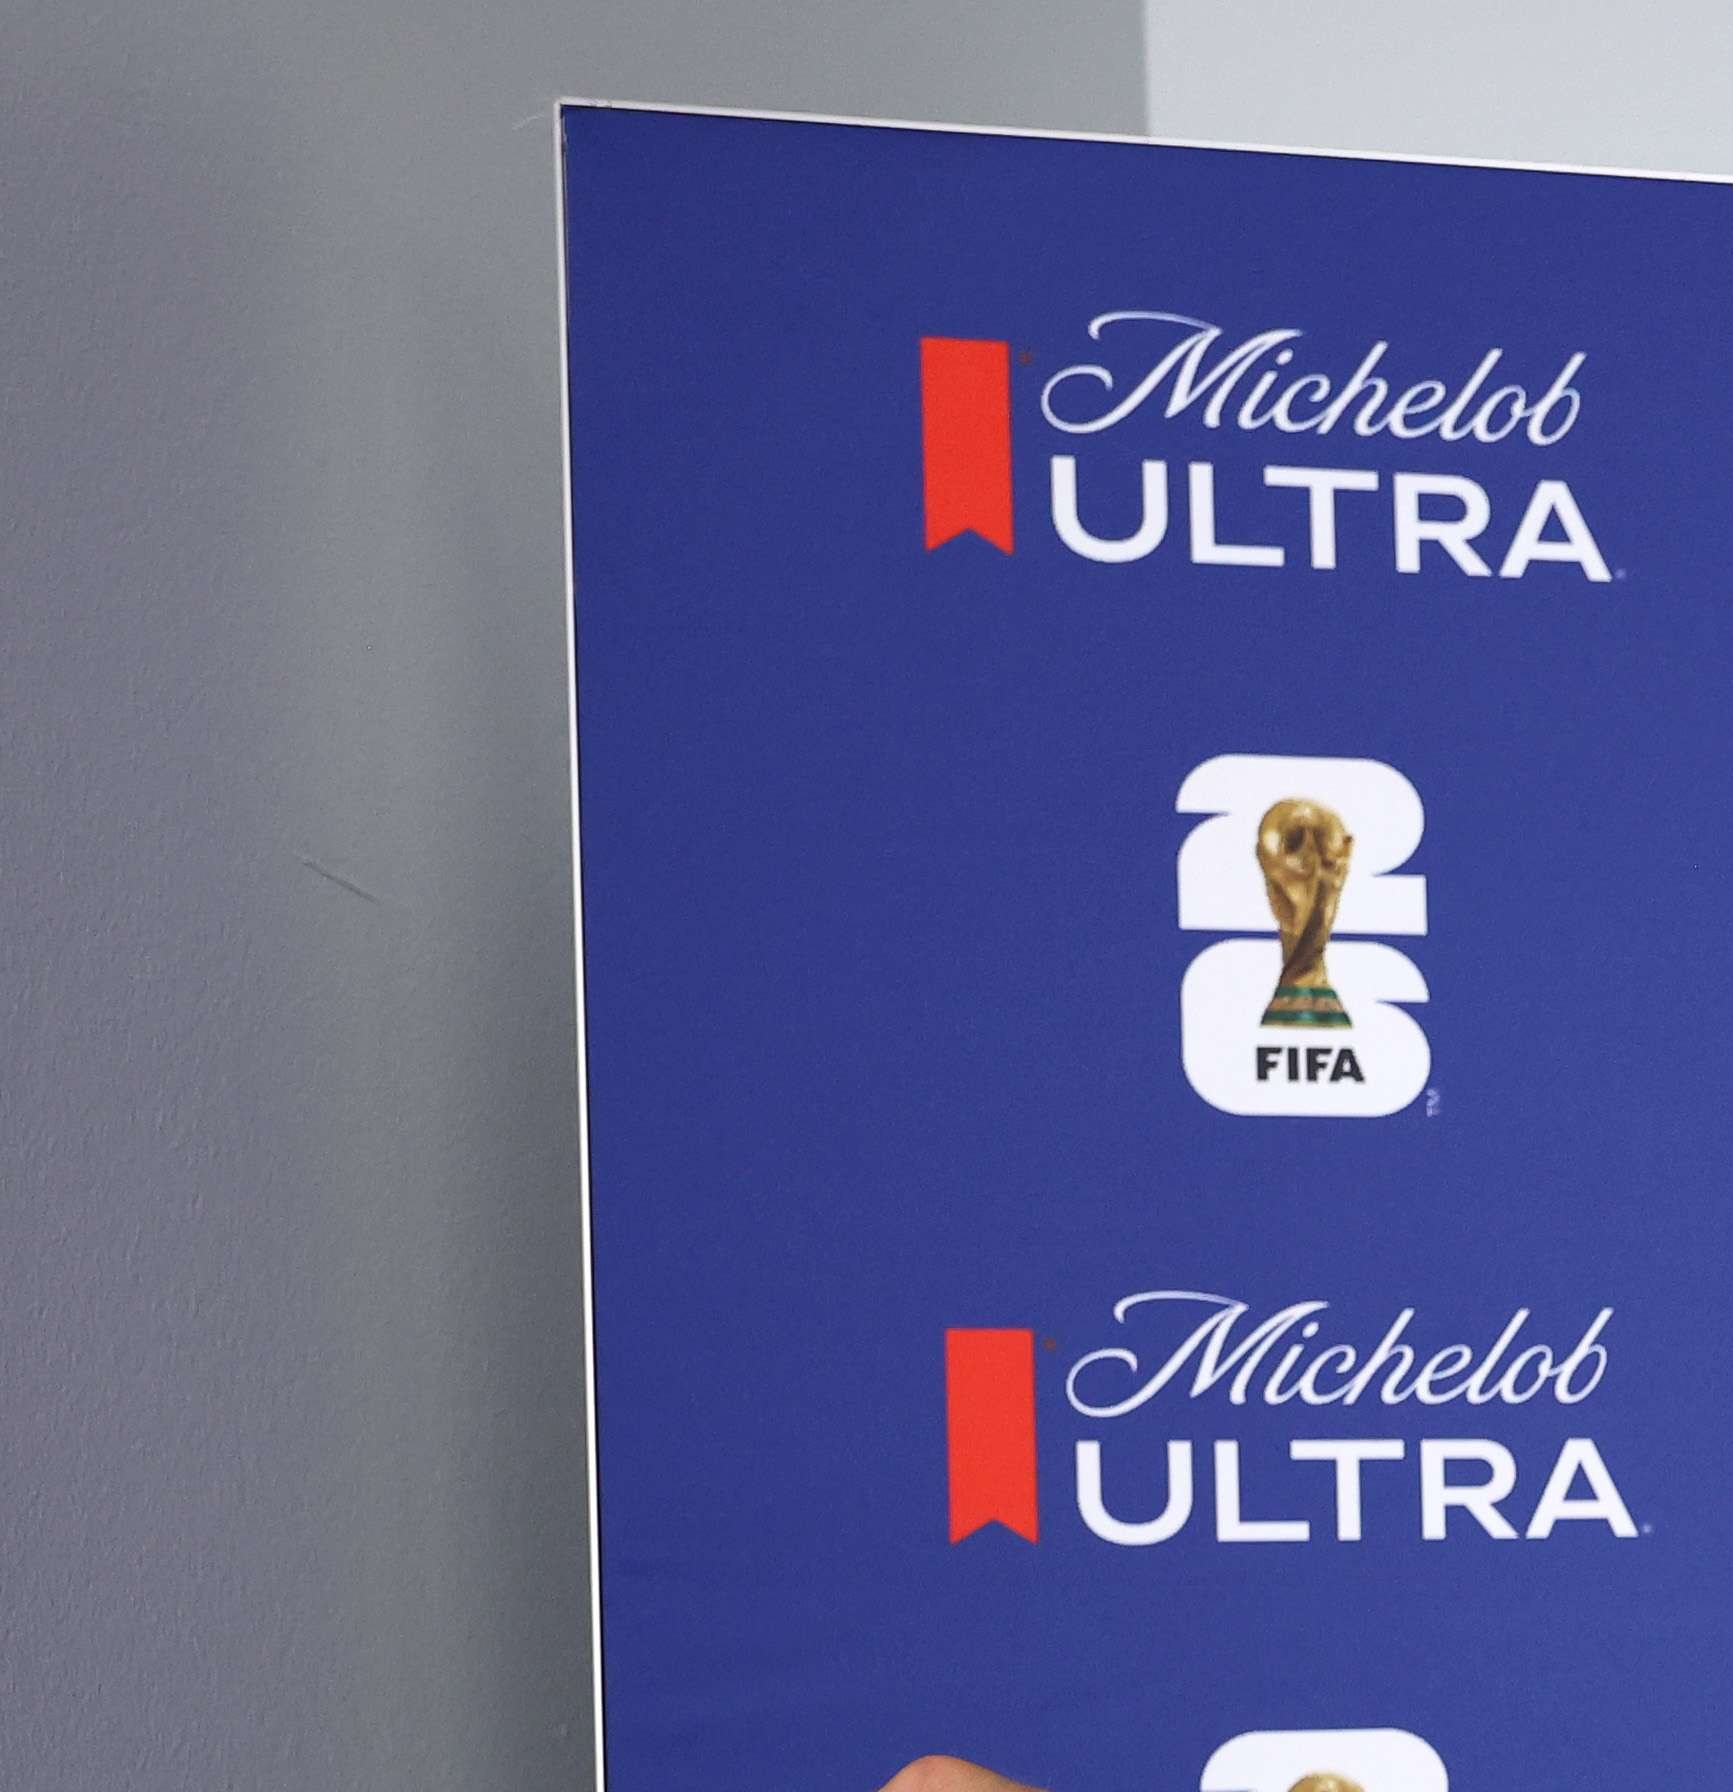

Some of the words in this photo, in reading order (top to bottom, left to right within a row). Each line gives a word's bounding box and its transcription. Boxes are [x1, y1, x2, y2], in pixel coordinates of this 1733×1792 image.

[1041, 311, 1586, 445] Michelob
[1051, 455, 1612, 582] ULTRA
[1256, 1046, 1365, 1082] FIFA
[1066, 1291, 1613, 1417] Michelob
[1076, 1438, 1638, 1545] ULTRA
